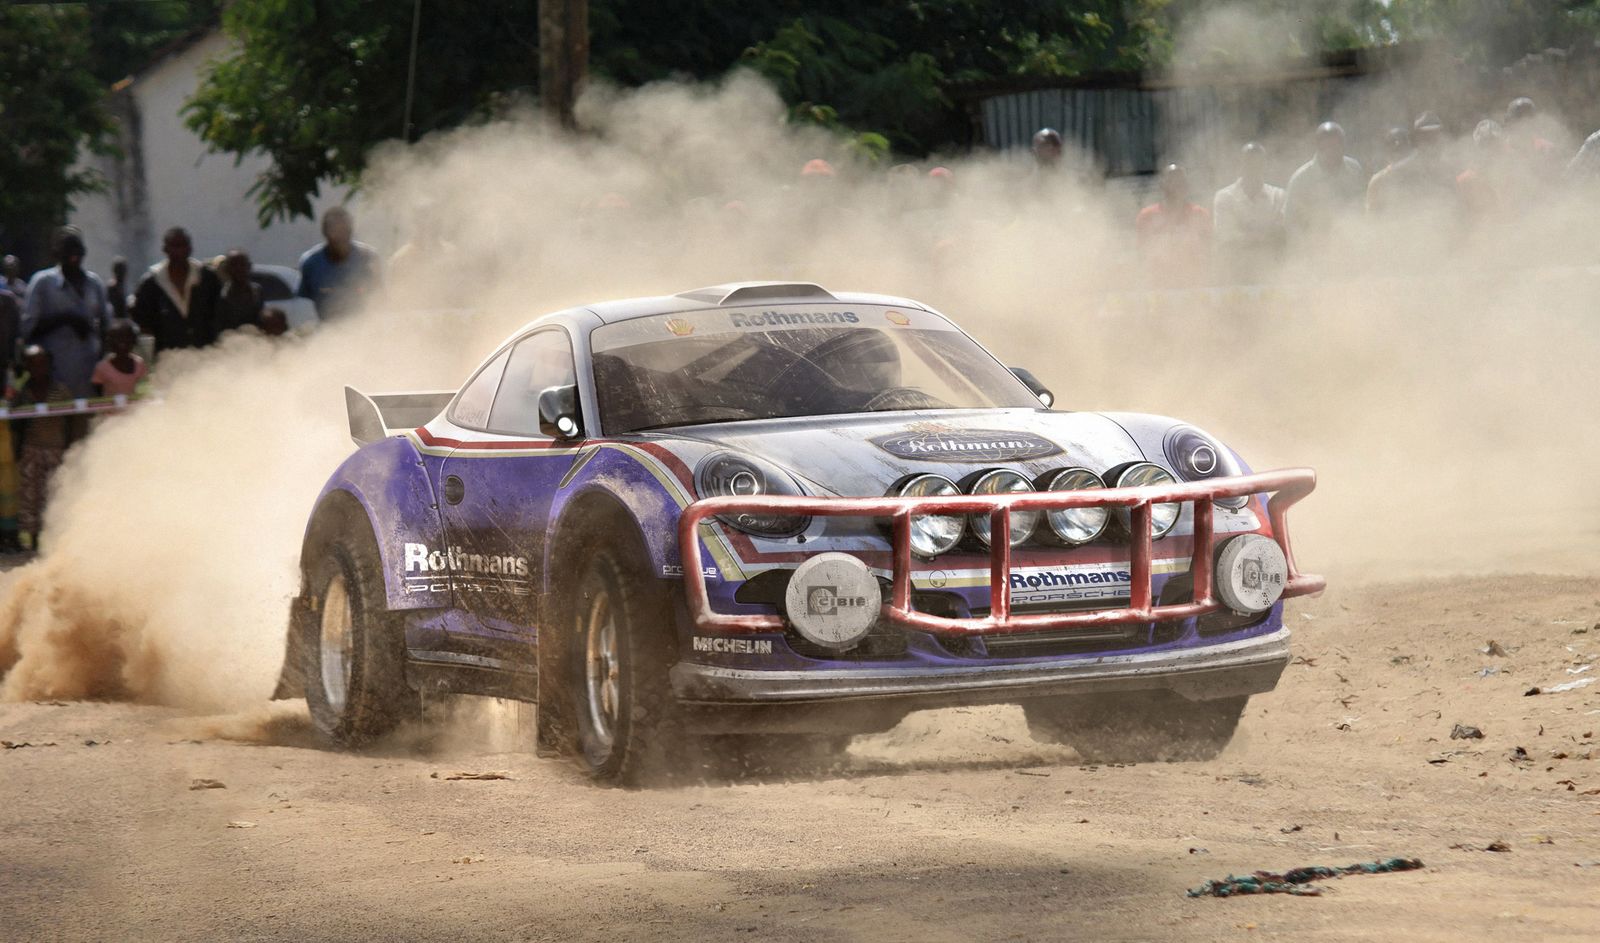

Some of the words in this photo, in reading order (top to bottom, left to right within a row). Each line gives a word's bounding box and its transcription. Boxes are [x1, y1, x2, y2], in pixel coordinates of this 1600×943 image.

[728, 310, 860, 328] Rothmans
[899, 438, 1037, 453] Rothmans
[404, 542, 529, 576] Rothmans
[1010, 570, 1131, 589] Rothmans
[1010, 589, 1131, 602] PORSCHE
[693, 636, 773, 655] MICHELIN
